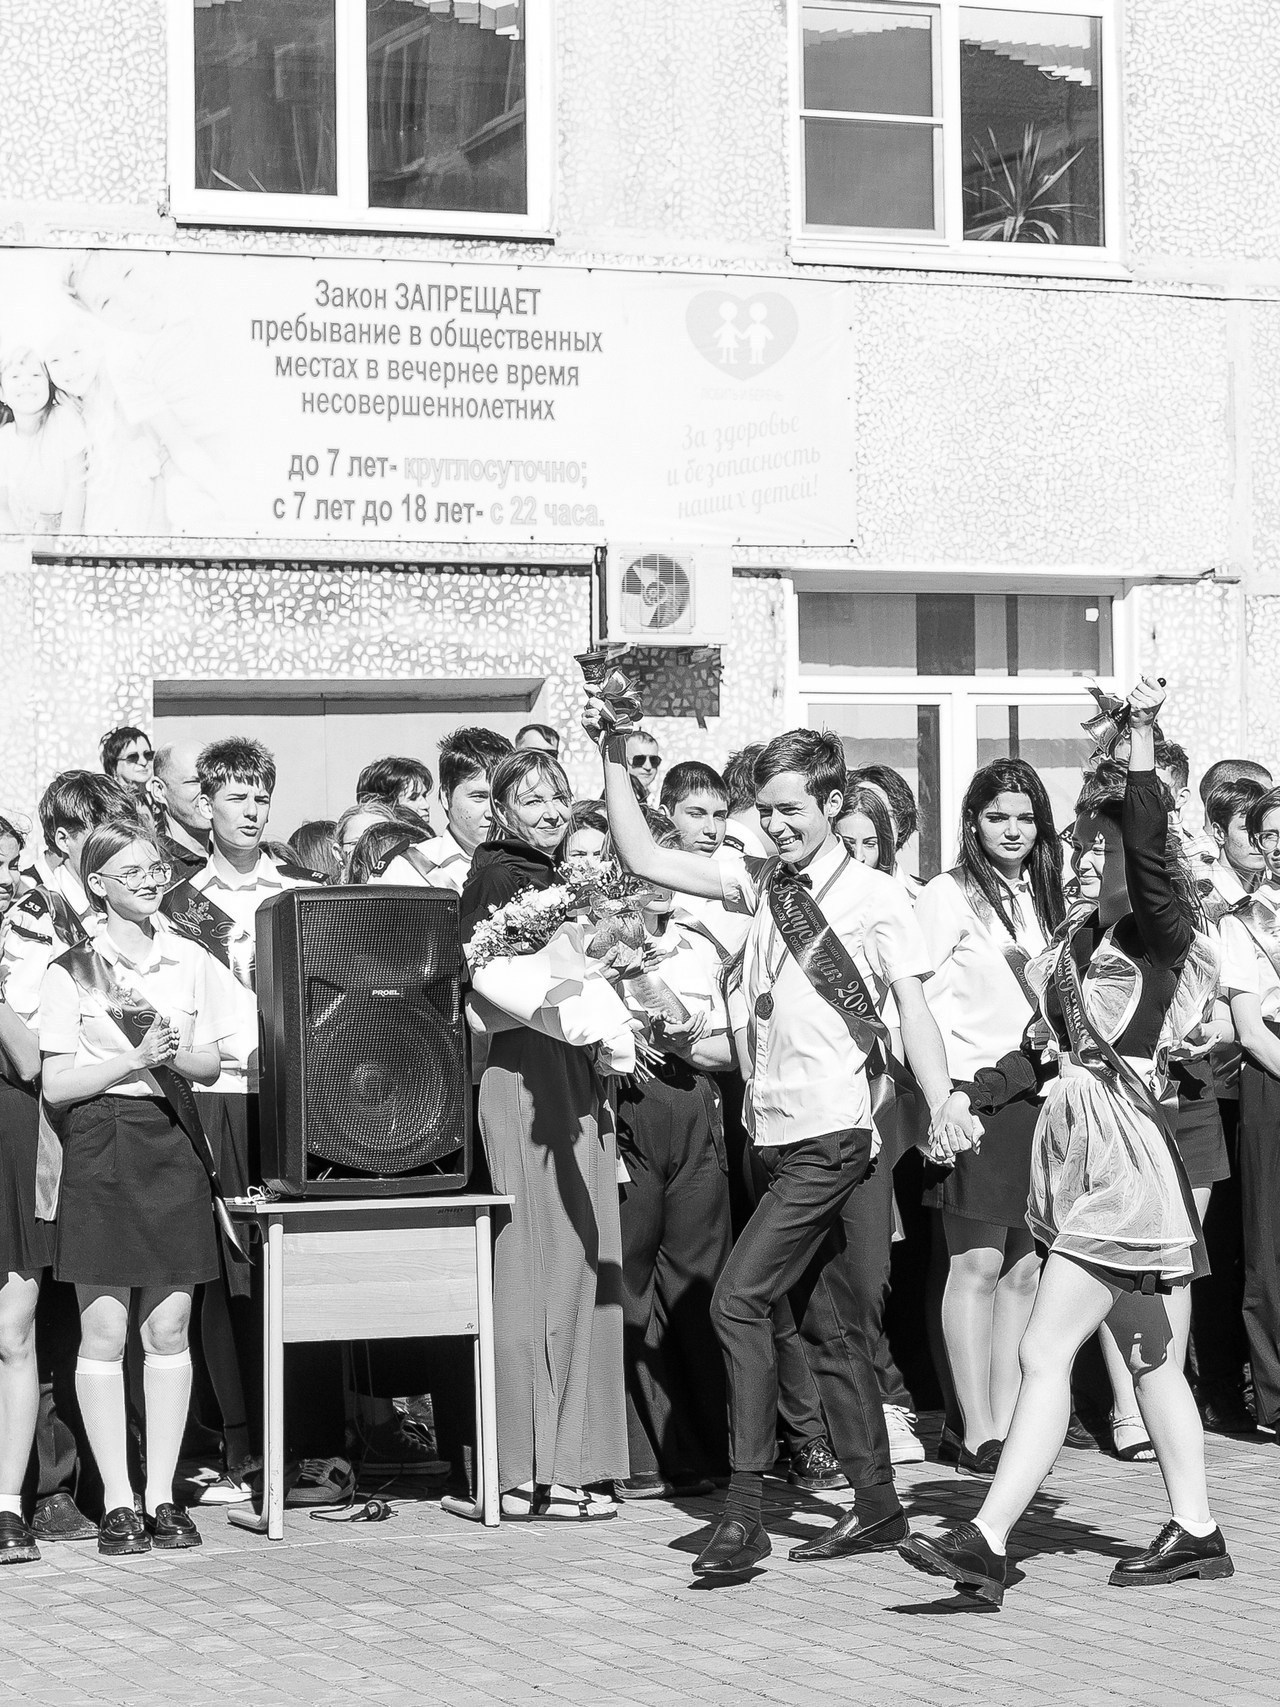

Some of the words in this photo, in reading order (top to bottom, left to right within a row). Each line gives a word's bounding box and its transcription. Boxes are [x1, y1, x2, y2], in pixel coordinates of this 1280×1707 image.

[315, 279, 387, 309] Закон
[395, 282, 542, 320] ЗАПРЕЩАЕТ
[251, 312, 401, 347] пребывание
[409, 325, 422, 346] в
[430, 318, 603, 353] общественных
[275, 356, 358, 380] местах
[366, 358, 379, 380] в
[387, 359, 498, 389] вечернее
[507, 364, 579, 391] время
[301, 392, 555, 422] несовершеннолетних
[682, 424, 706, 450] За
[713, 411, 800, 452] здоровье
[288, 454, 319, 481] до
[327, 448, 340, 476] 7
[347, 456, 397, 478] лет-
[404, 457, 587, 489] круглосуточно;
[667, 468, 679, 486] и
[684, 446, 821, 488] безопасность
[273, 498, 286, 520] с
[293, 491, 306, 519] 7
[314, 498, 355, 520] лет
[361, 500, 393, 526] до
[401, 493, 427, 522] 18
[434, 501, 484, 524] лет-
[489, 502, 504, 525] с
[510, 495, 537, 525] 22
[544, 503, 605, 526] часа.
[678, 490, 745, 519] наших
[752, 474, 818, 513] детей!
[773, 903, 787, 921] МАОУ
[372, 989, 400, 997] PROEL
